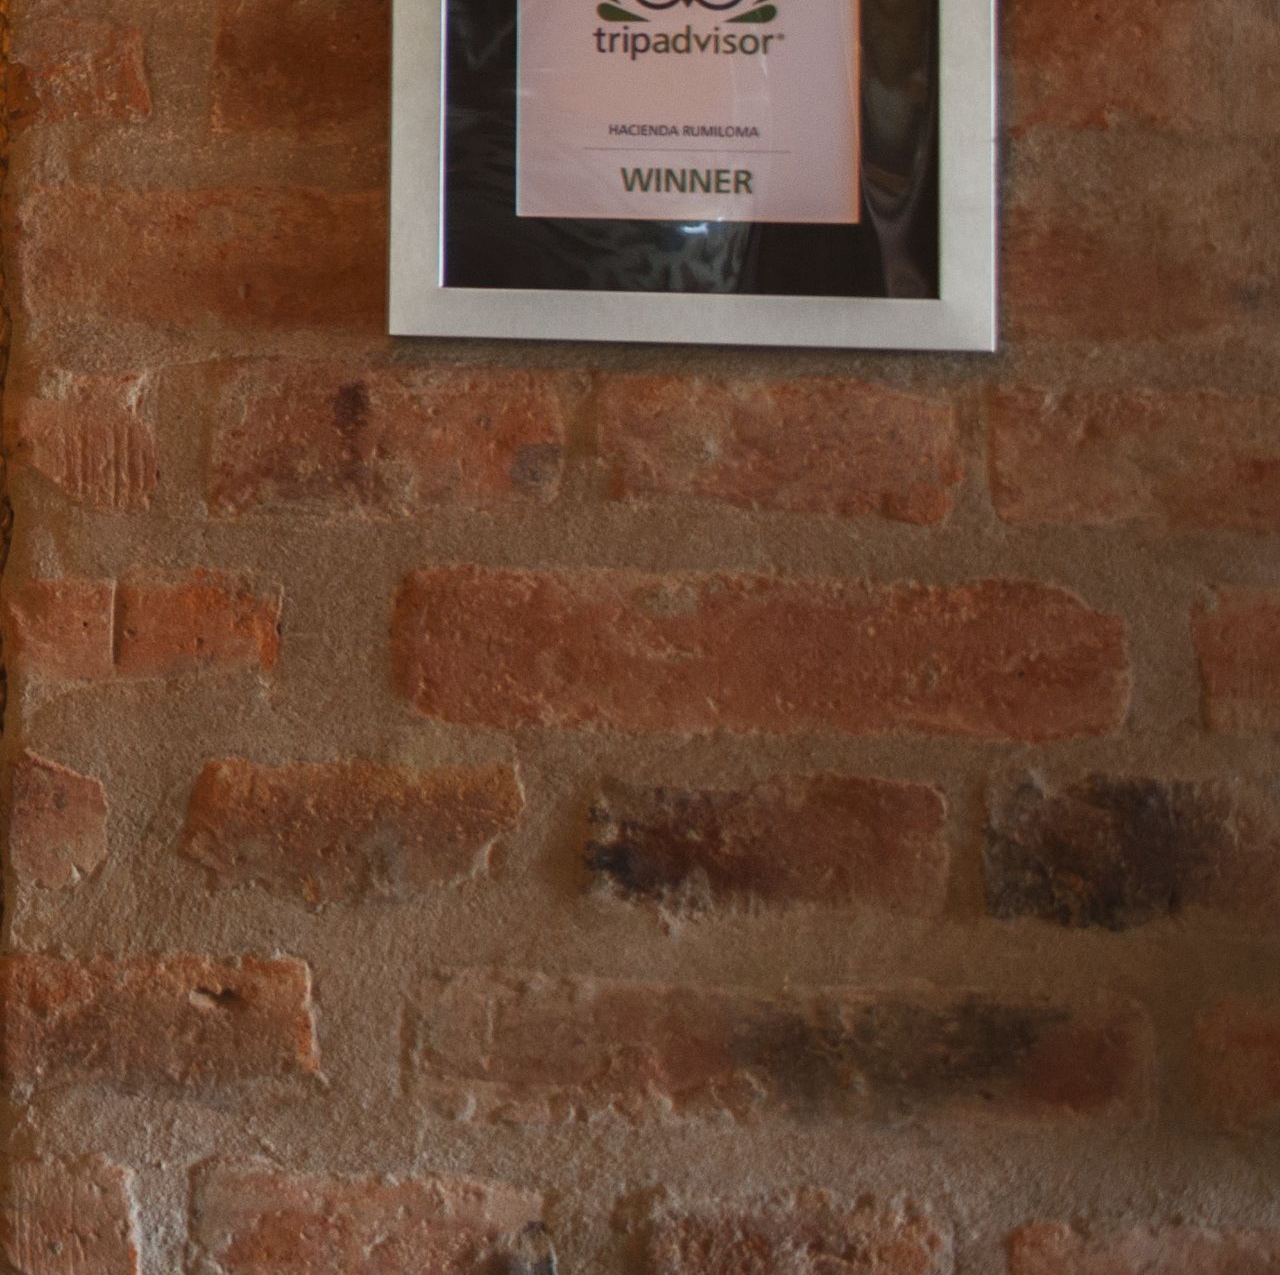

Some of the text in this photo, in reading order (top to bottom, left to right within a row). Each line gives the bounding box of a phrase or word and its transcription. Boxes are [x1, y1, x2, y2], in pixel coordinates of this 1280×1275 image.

[593, 25, 774, 61] tripadvisor
[608, 123, 760, 140] HACIENDA RUMILOMA
[621, 166, 754, 195] WINNER
